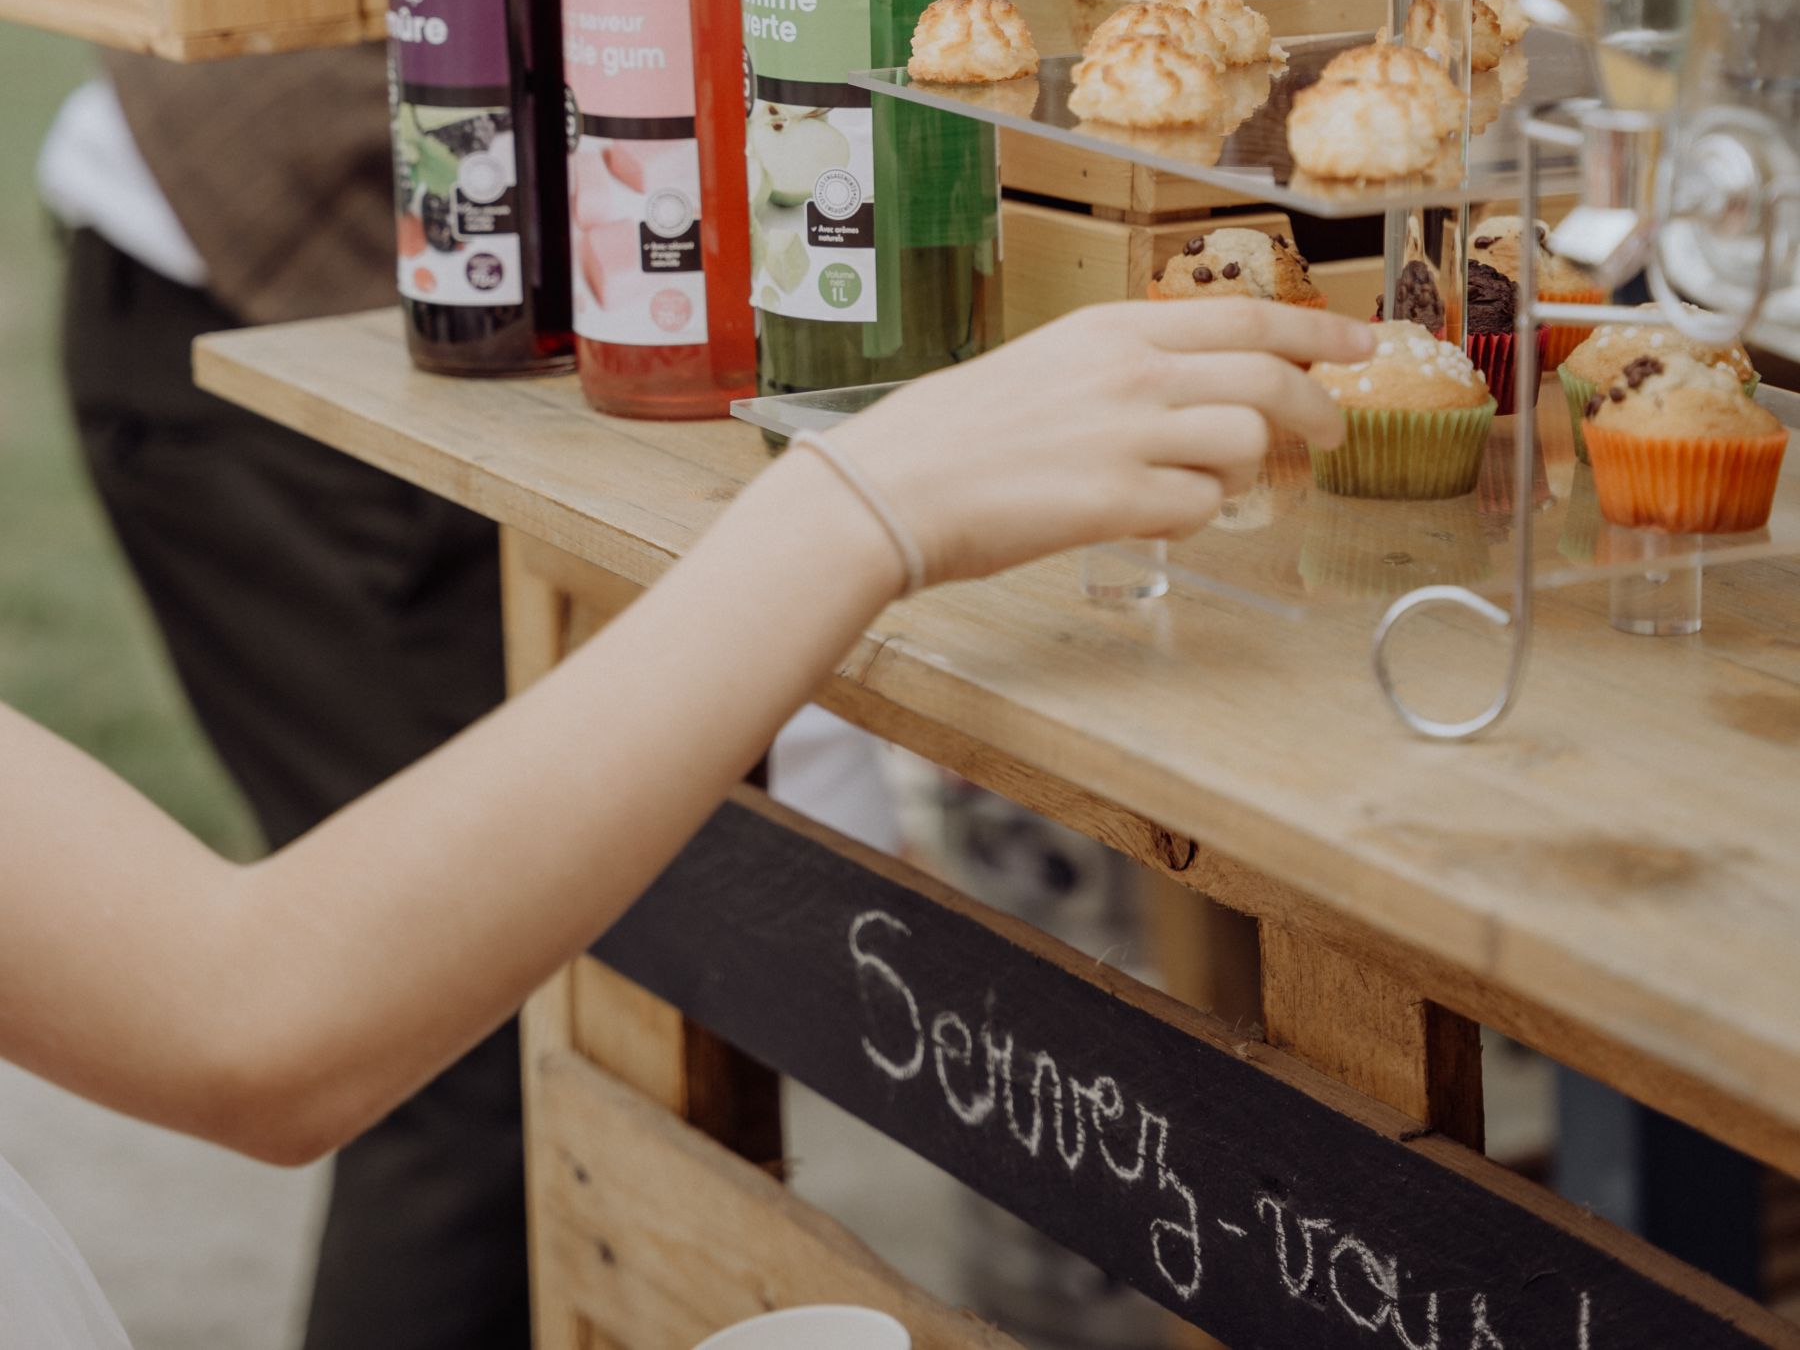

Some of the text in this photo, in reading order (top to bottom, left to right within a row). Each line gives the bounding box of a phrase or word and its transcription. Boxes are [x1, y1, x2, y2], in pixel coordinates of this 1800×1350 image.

[604, 47, 666, 78] gum
[818, 224, 859, 234] Avec arômes
[818, 233, 844, 243] naturels
[824, 270, 855, 280] Volume
[832, 287, 848, 302] 1L
